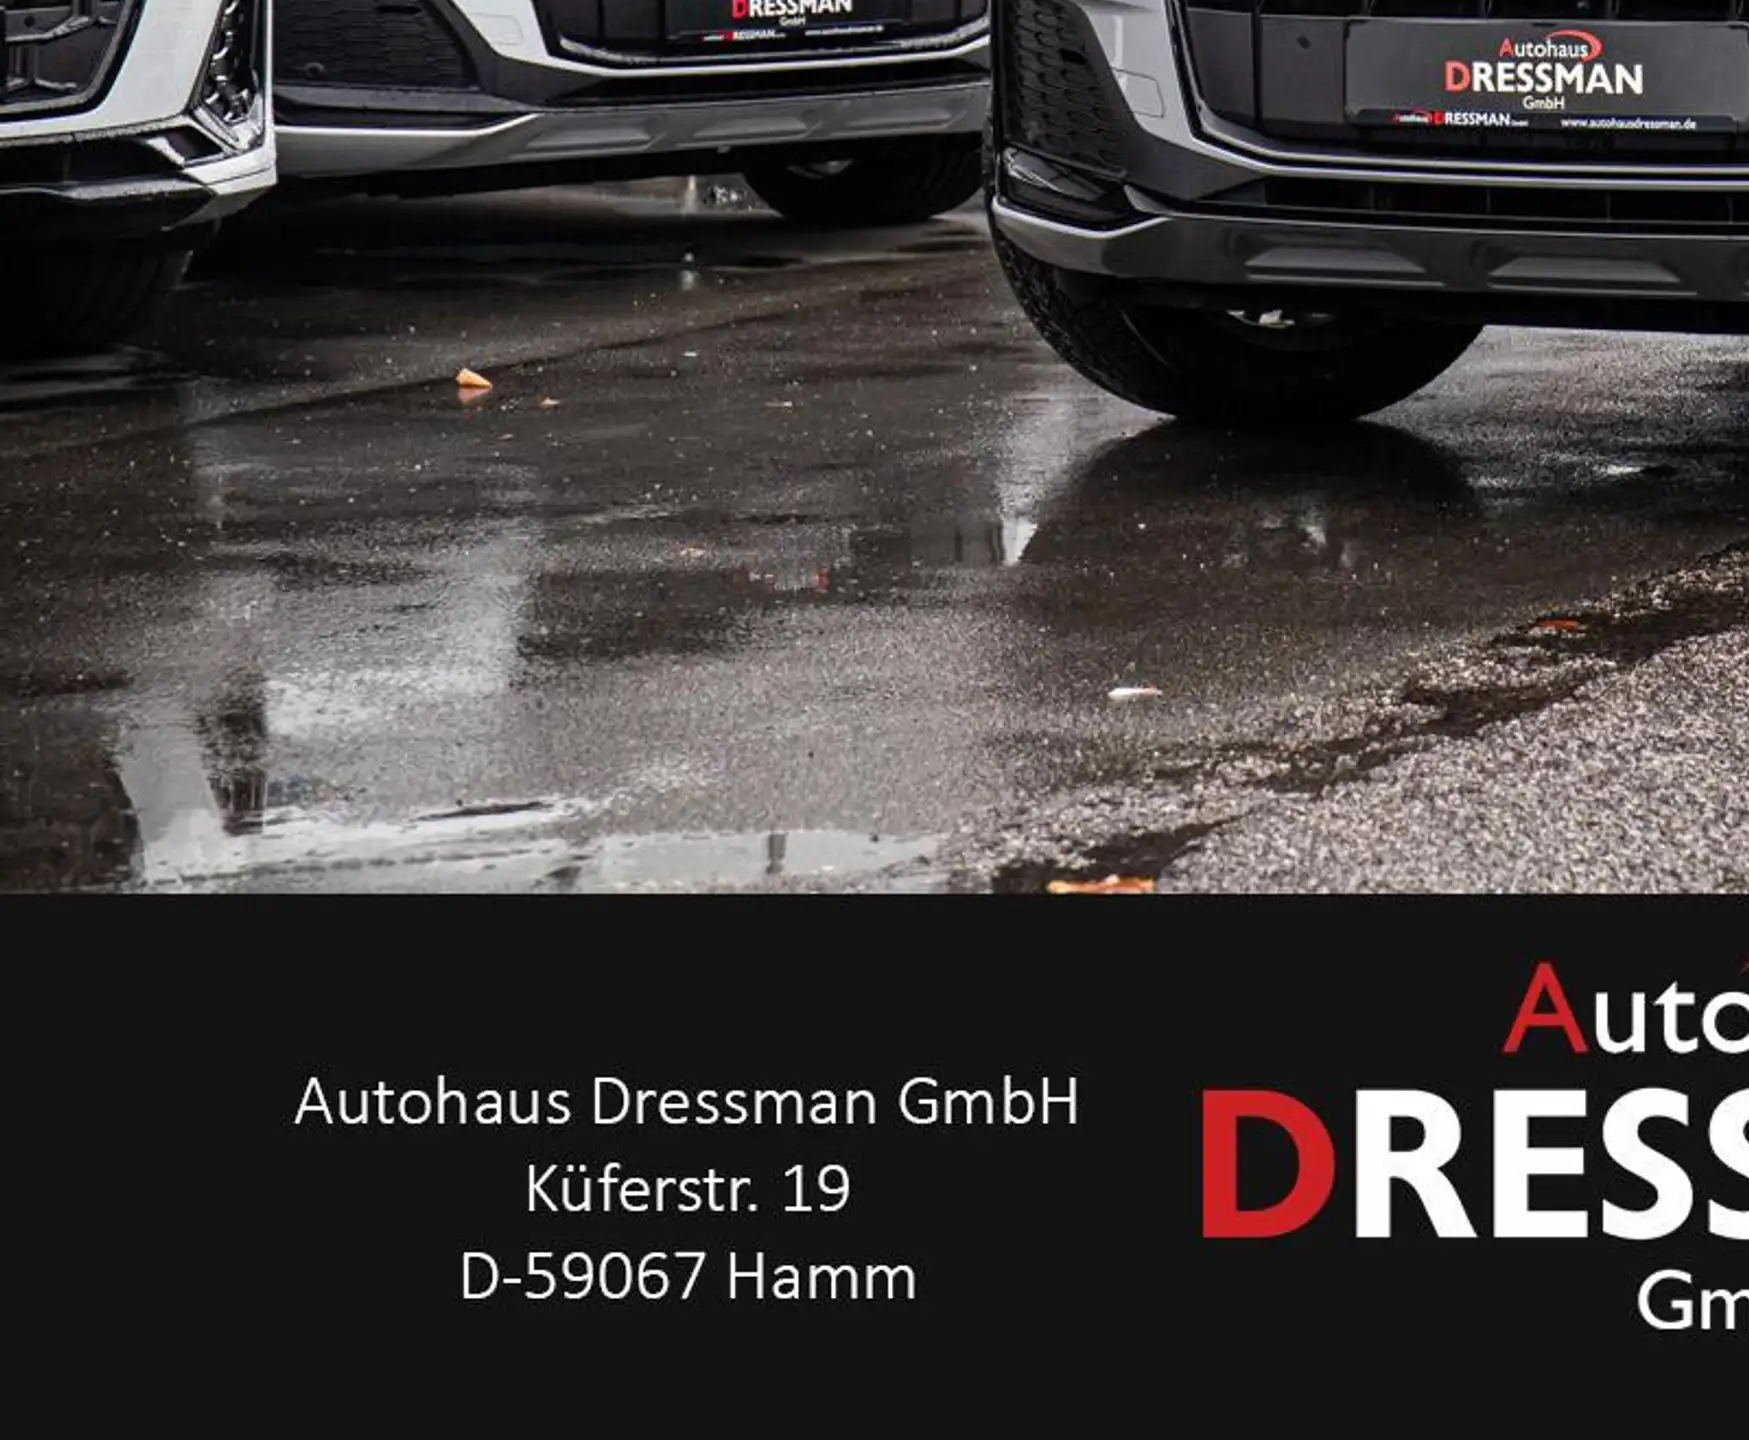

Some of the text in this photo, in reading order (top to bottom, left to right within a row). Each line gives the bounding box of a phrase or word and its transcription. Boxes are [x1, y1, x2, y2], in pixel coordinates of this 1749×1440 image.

[1500, 36, 1589, 58] Autohaus
[1445, 61, 1644, 95] DRESSMAN
[1522, 96, 1566, 110] GmbH
[1433, 112, 1512, 127] DRESSMAN
